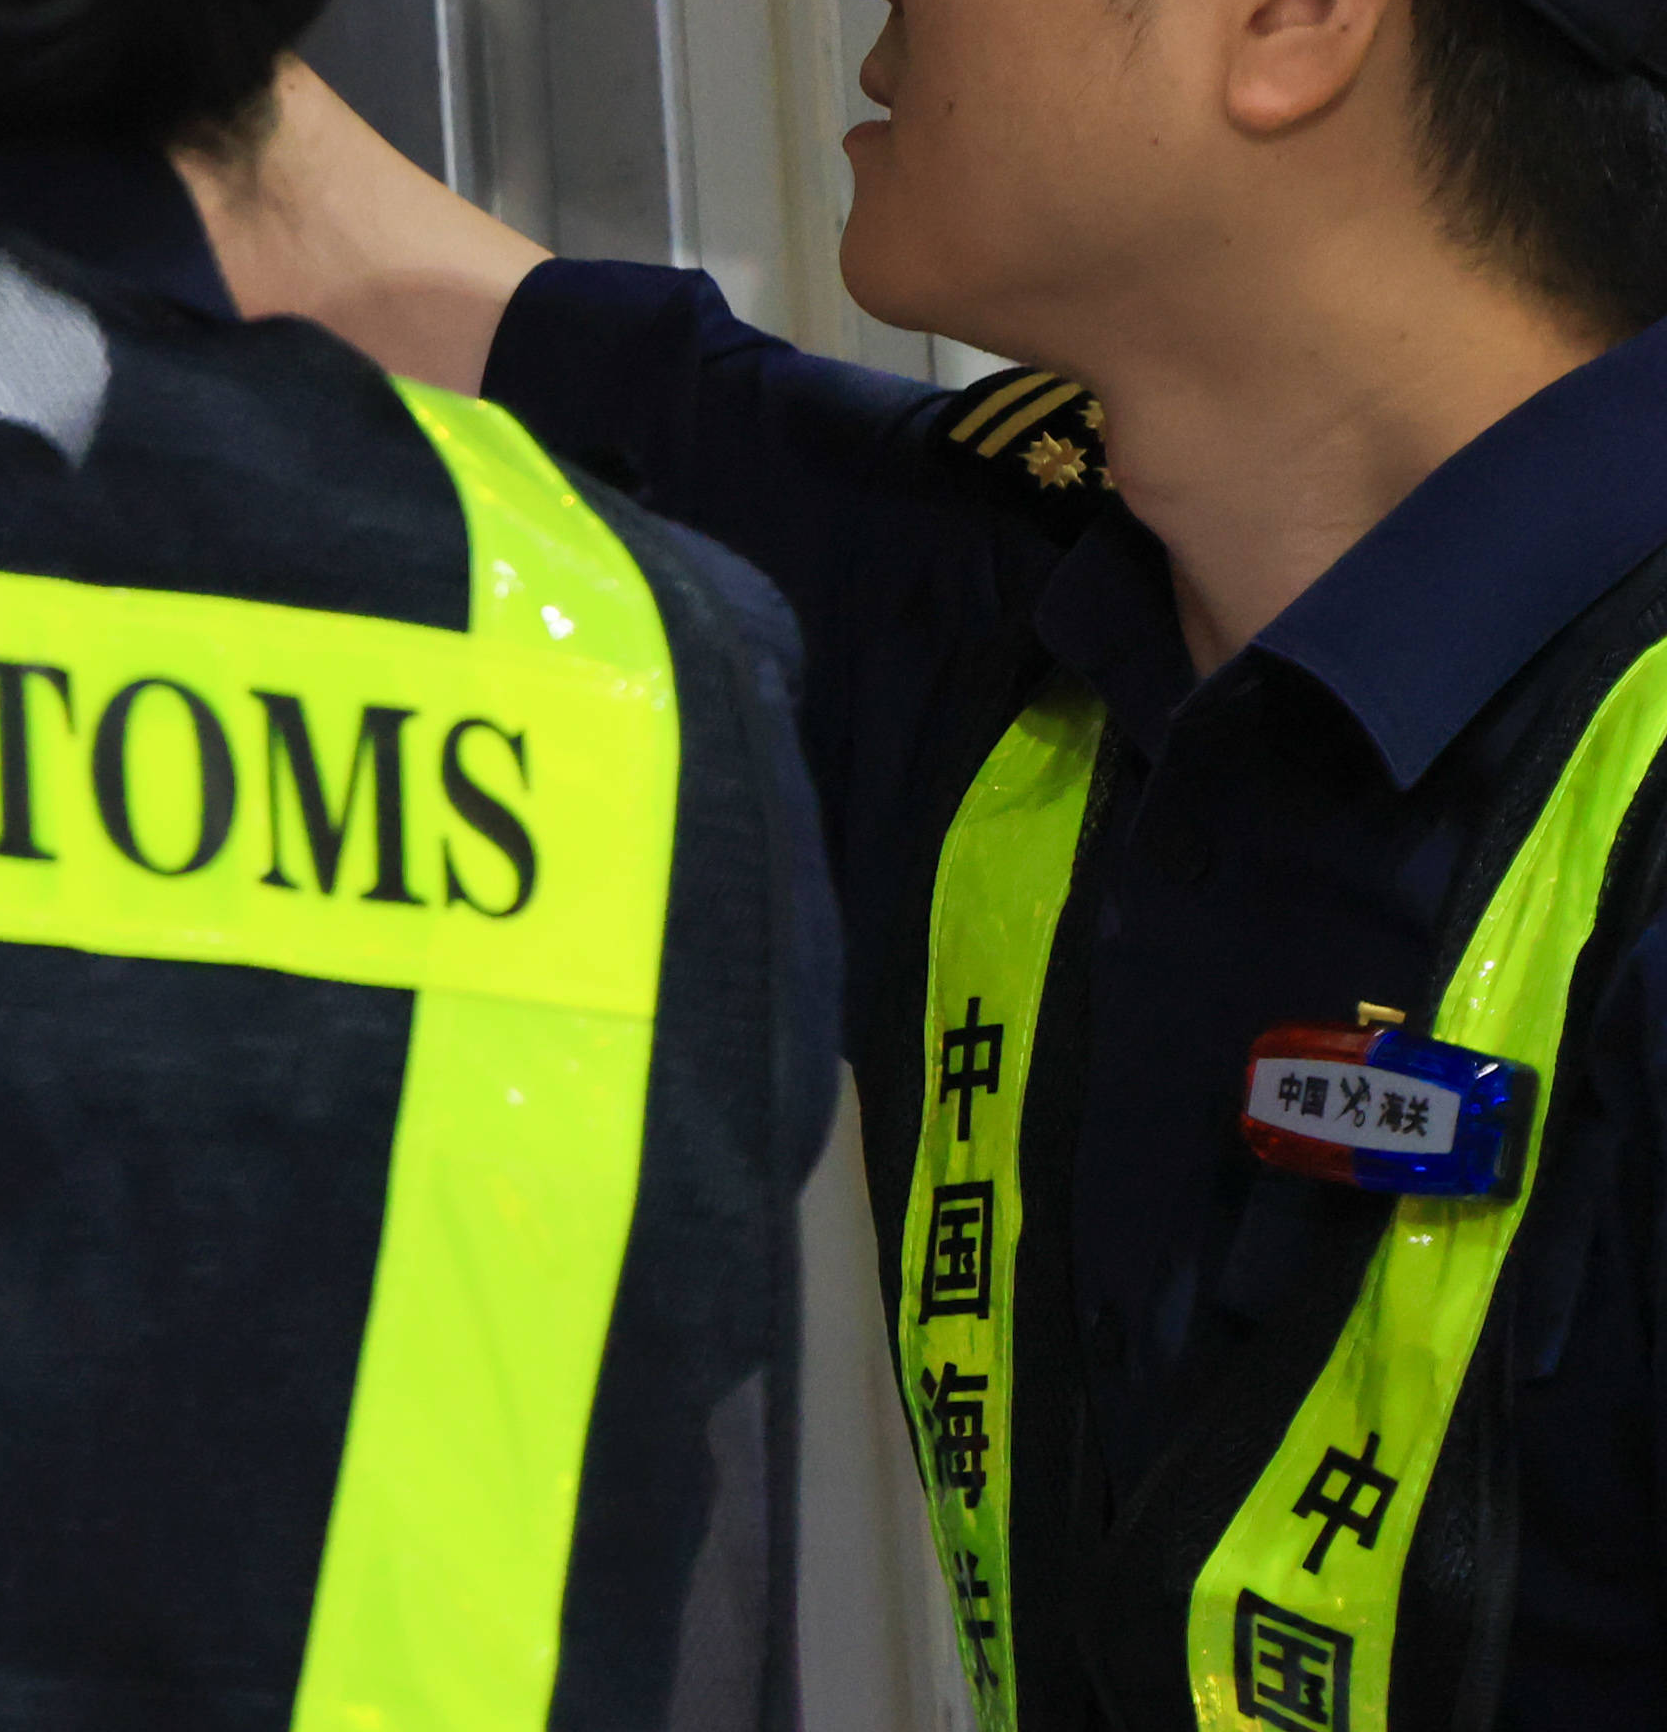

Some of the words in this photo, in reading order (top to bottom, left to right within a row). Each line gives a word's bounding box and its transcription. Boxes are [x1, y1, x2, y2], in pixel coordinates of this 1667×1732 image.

[1278, 1073, 1329, 1118] 中国
[1377, 1091, 1429, 1137] 海关
[1235, 1431, 1398, 1732] 中国
